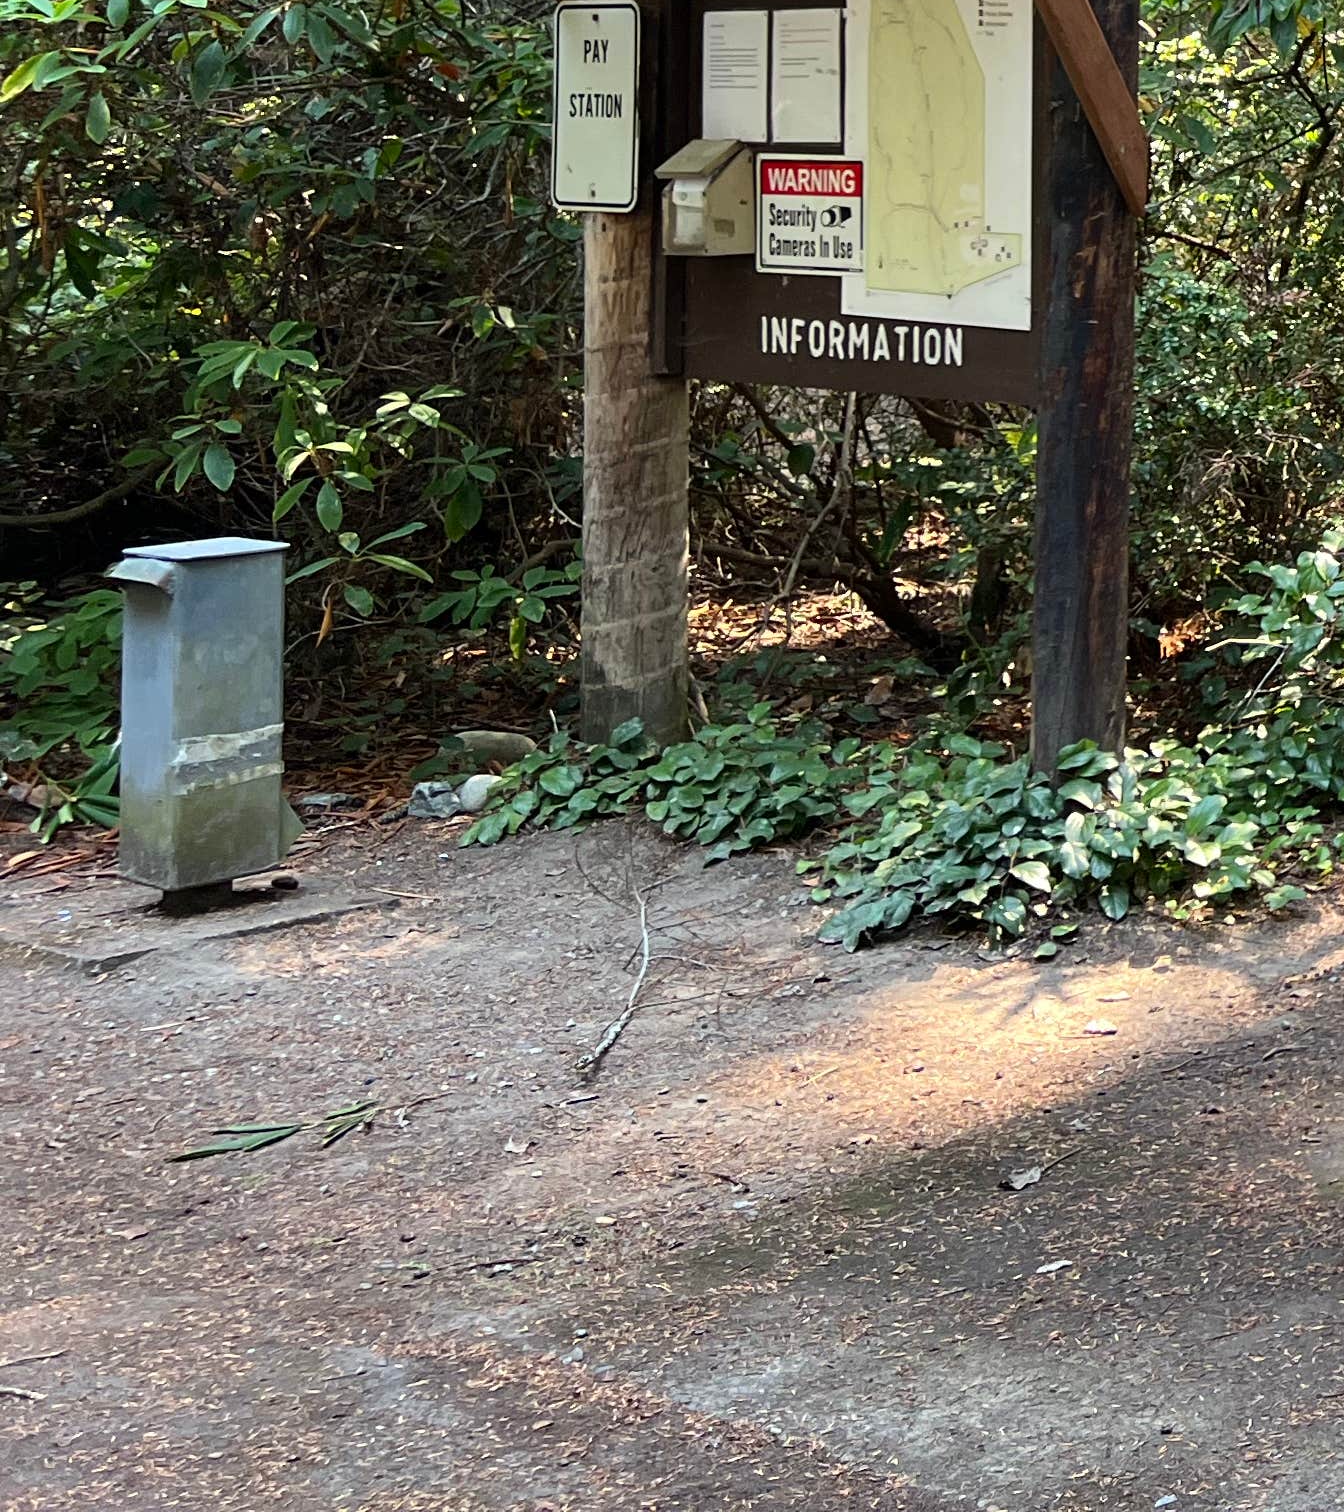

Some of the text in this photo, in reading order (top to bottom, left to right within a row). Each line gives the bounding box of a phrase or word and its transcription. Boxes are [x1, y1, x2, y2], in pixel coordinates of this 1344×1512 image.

[583, 39, 609, 64] PAY
[569, 93, 623, 119] STATION
[767, 167, 856, 194] WARNING
[769, 202, 817, 232] Security
[769, 232, 853, 259] Cameras In Use
[761, 315, 963, 367] INFORMATION
